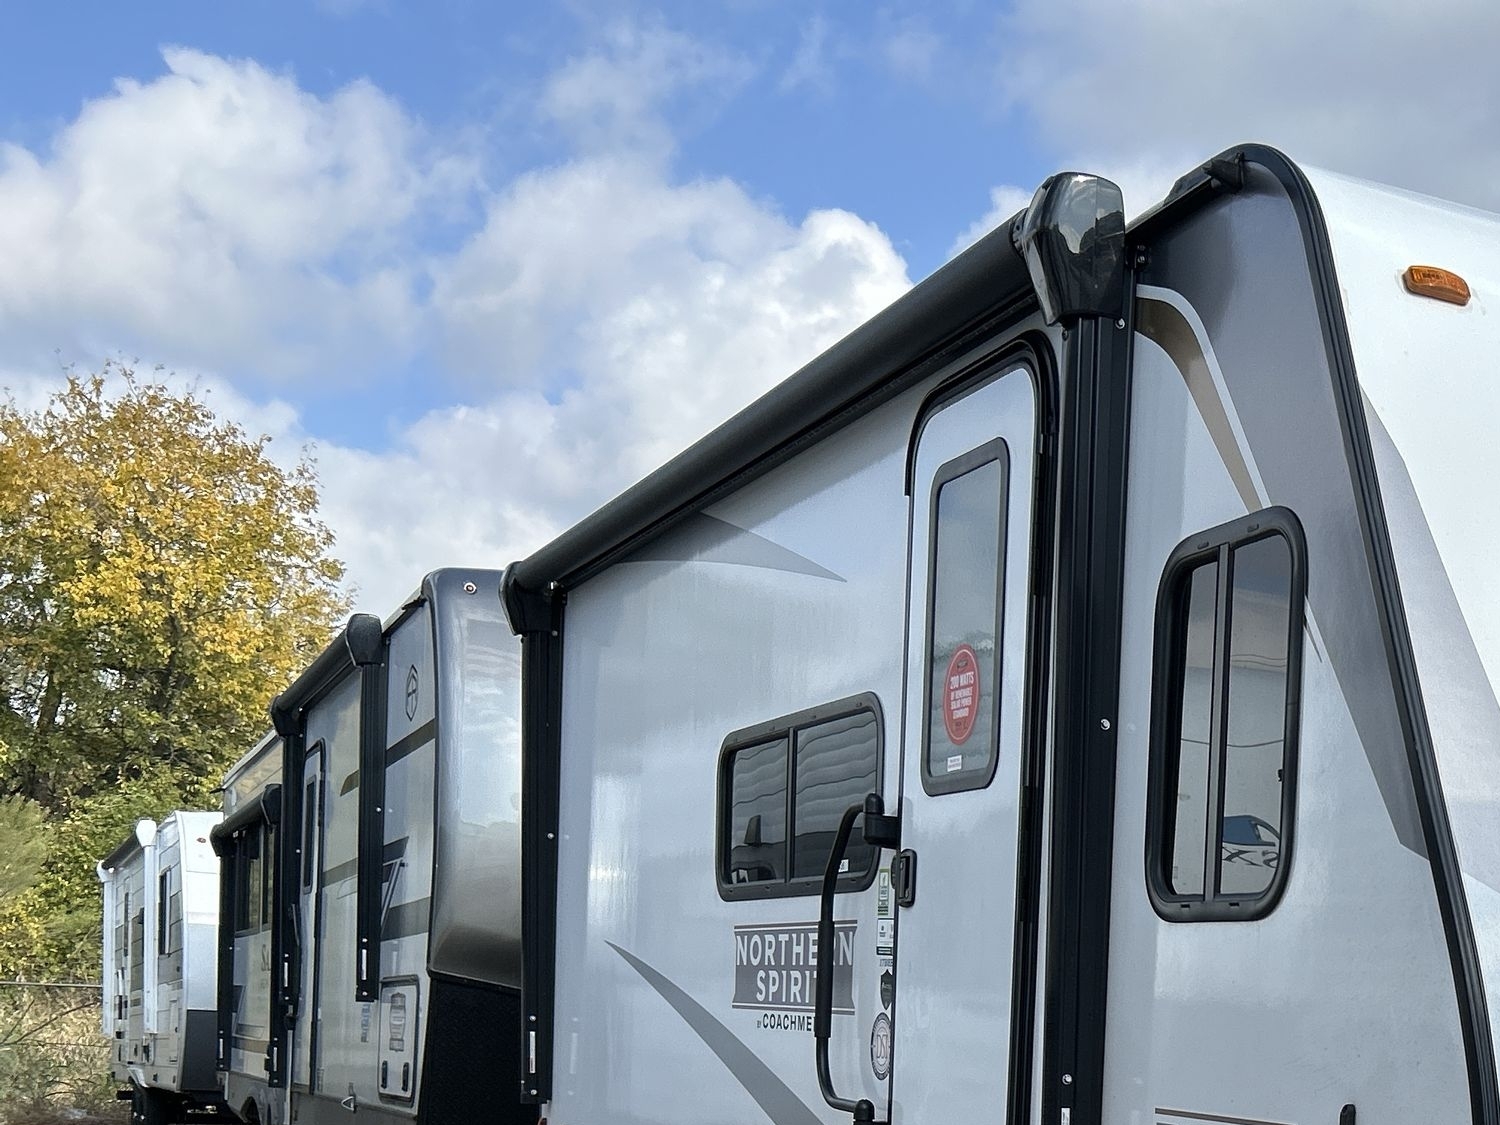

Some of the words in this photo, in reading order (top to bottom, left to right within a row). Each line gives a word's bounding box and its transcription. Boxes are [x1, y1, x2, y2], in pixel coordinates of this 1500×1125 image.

[736, 931, 853, 966] NORTHEN
[756, 969, 817, 1003] SPIRI
[762, 1013, 816, 1032] COACHME
